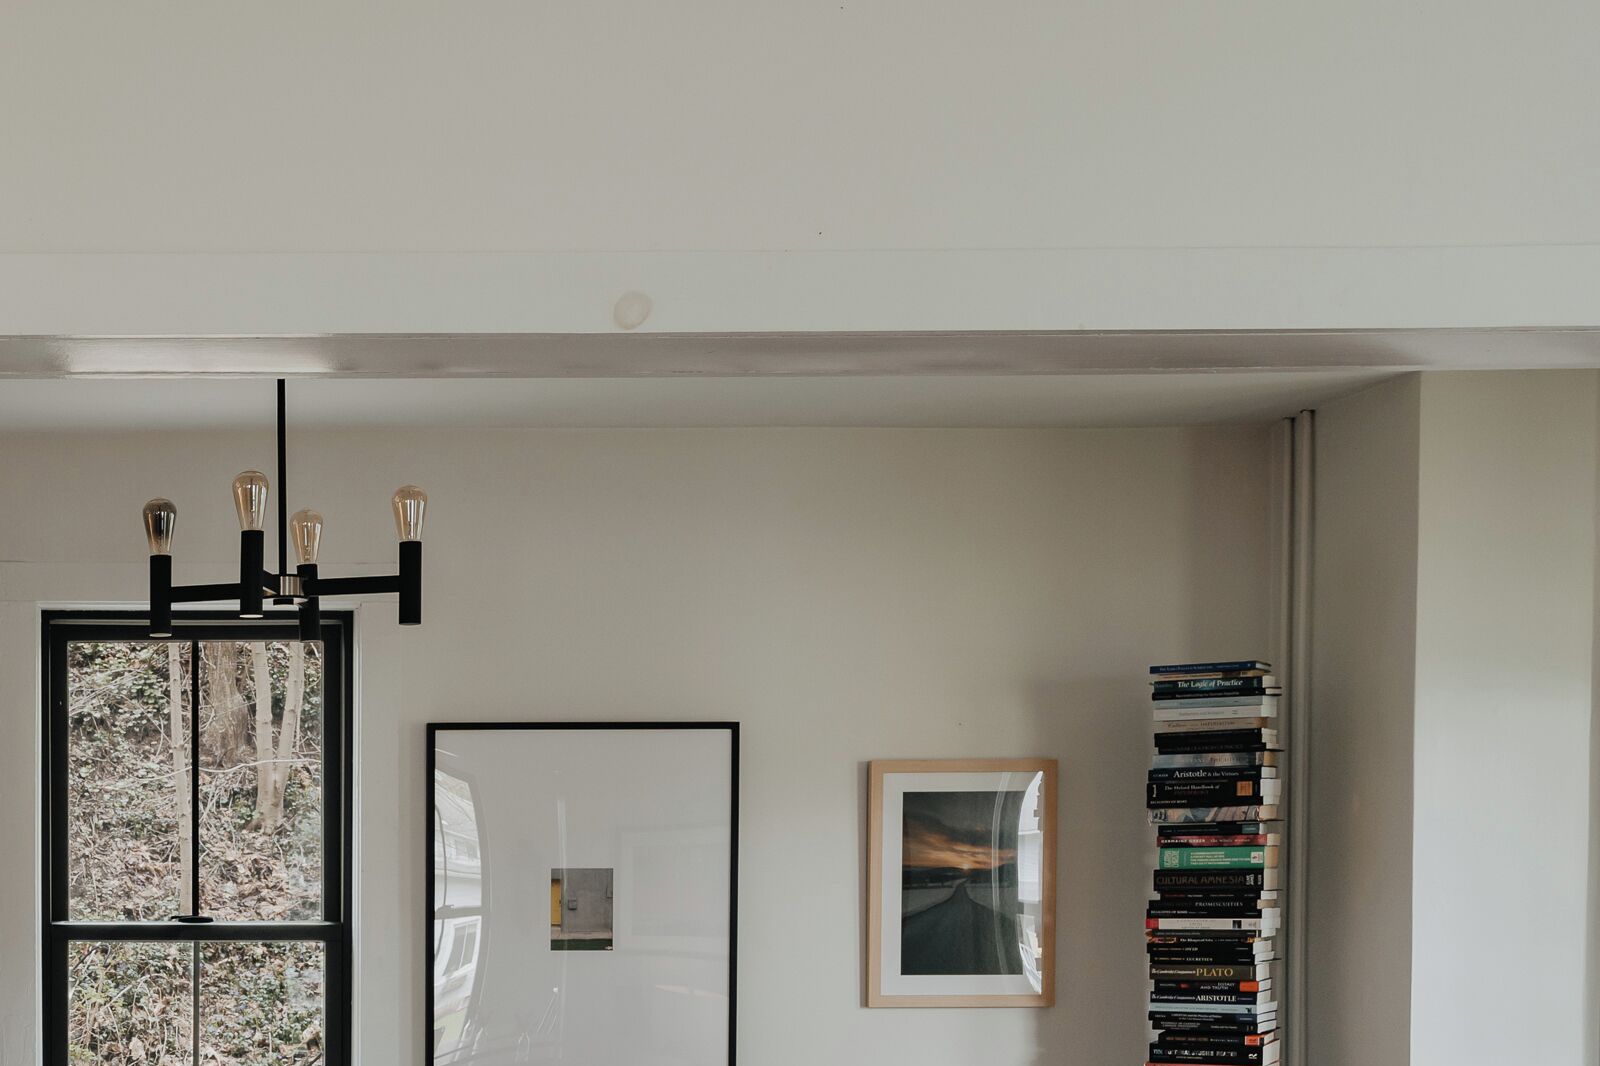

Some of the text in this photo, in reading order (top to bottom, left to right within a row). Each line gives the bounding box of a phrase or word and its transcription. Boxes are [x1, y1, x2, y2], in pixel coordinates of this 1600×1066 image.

[1190, 680, 1207, 689] Logic
[1216, 679, 1243, 687] Practice
[1173, 770, 1207, 778] Aristotle
[1156, 876, 1198, 885] CULTURAL
[1200, 875, 1245, 884] AMNESIA
[1196, 968, 1233, 977] PLATO
